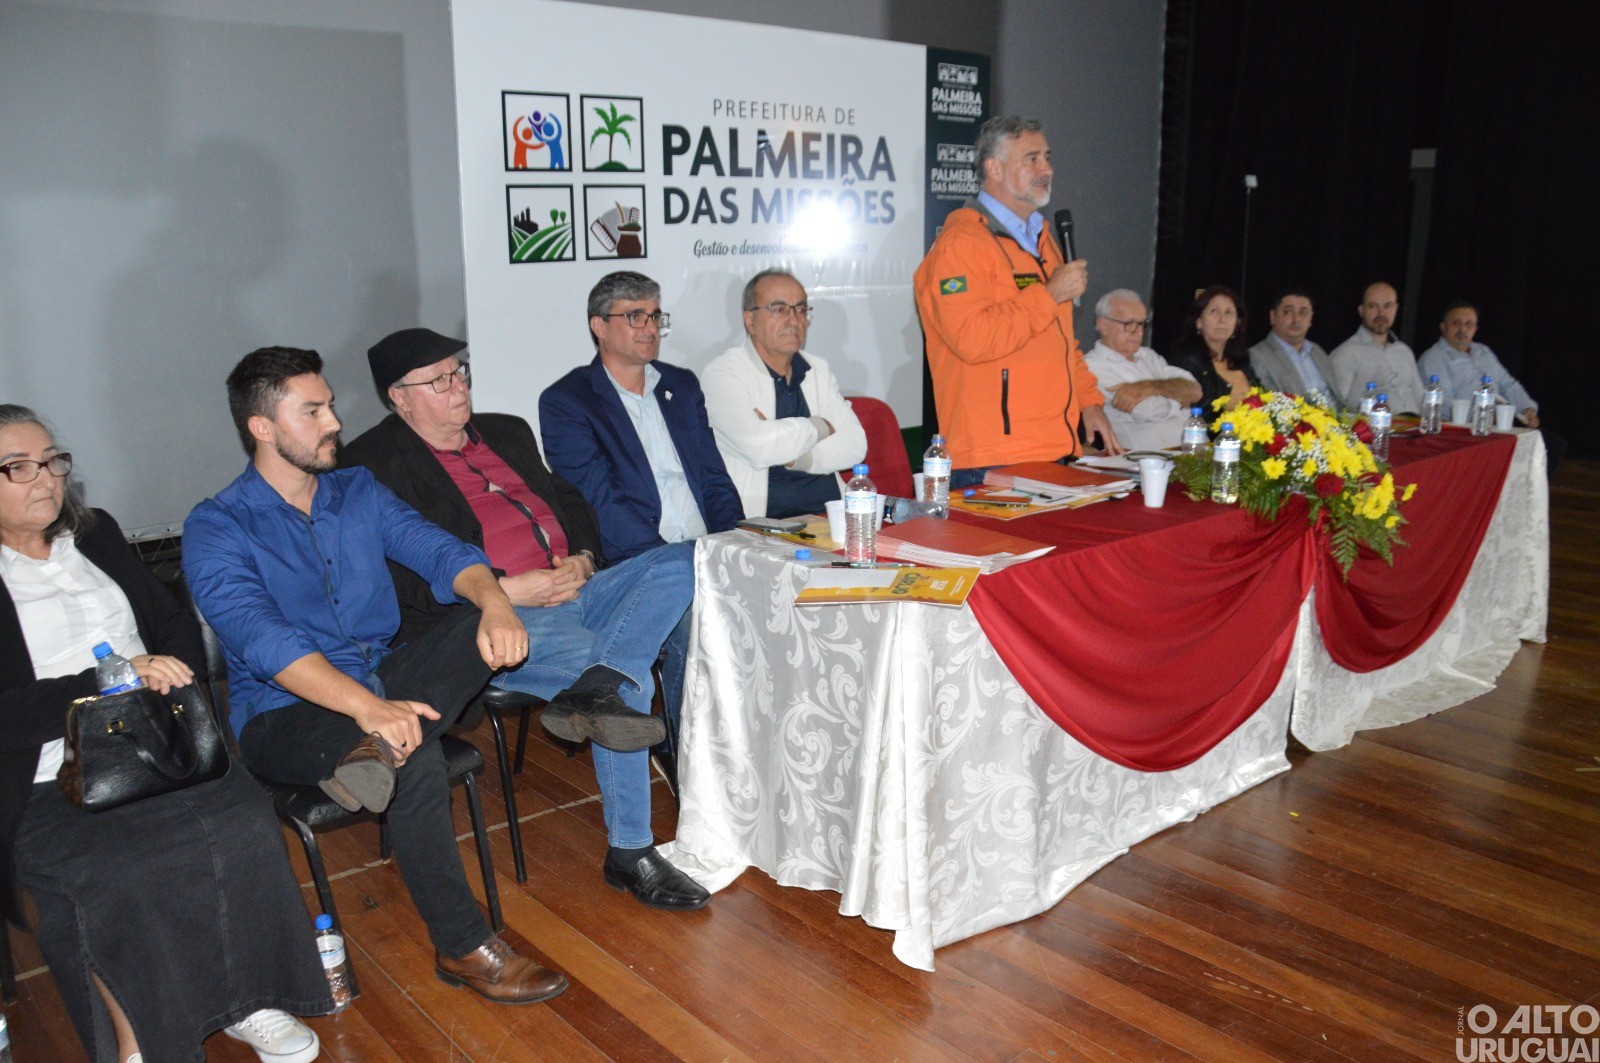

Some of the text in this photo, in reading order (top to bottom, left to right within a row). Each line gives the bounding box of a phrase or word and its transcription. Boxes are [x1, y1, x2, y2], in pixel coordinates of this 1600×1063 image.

[932, 86, 982, 104] PALMEIRA
[713, 98, 856, 126] PREFEITURA DE
[932, 101, 948, 113] DAS
[662, 124, 896, 181] PALMEIRA
[931, 182, 947, 192] DAS
[663, 186, 740, 226] DAS
[693, 239, 729, 258] Gestão
[731, 245, 738, 255] e
